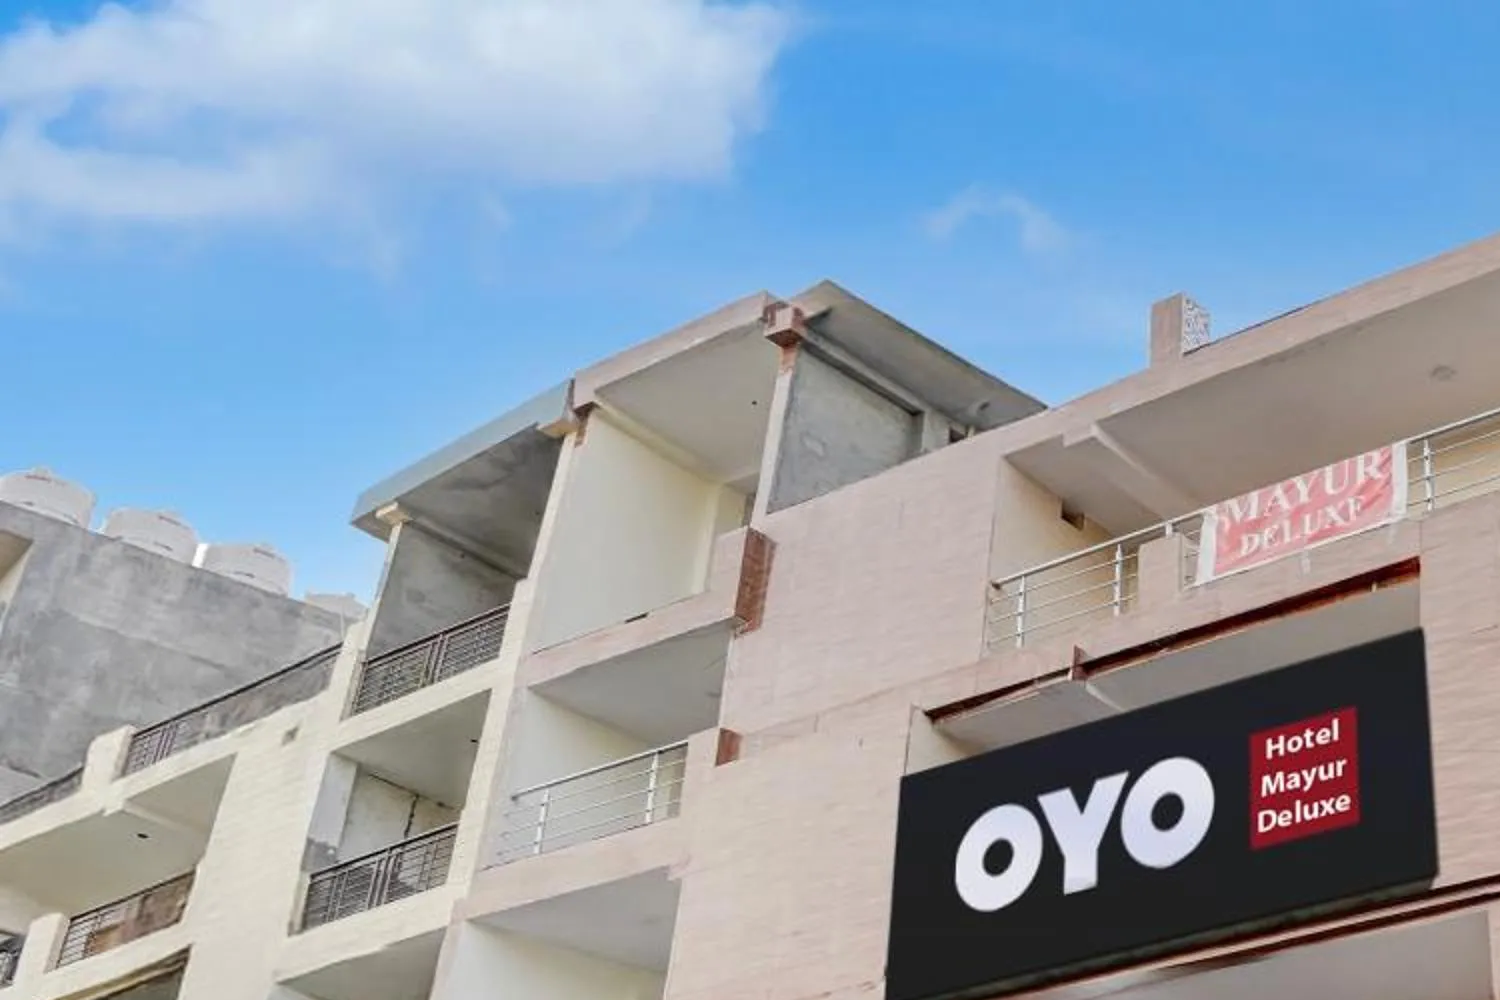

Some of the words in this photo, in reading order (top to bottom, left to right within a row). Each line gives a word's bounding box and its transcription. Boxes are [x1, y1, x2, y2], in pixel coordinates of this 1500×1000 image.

[1224, 451, 1383, 524] MAYUR
[1265, 718, 1340, 760] Hotel
[1260, 758, 1348, 798] Mayur
[955, 757, 1215, 912] OYO
[1257, 794, 1352, 833] Deluxe
